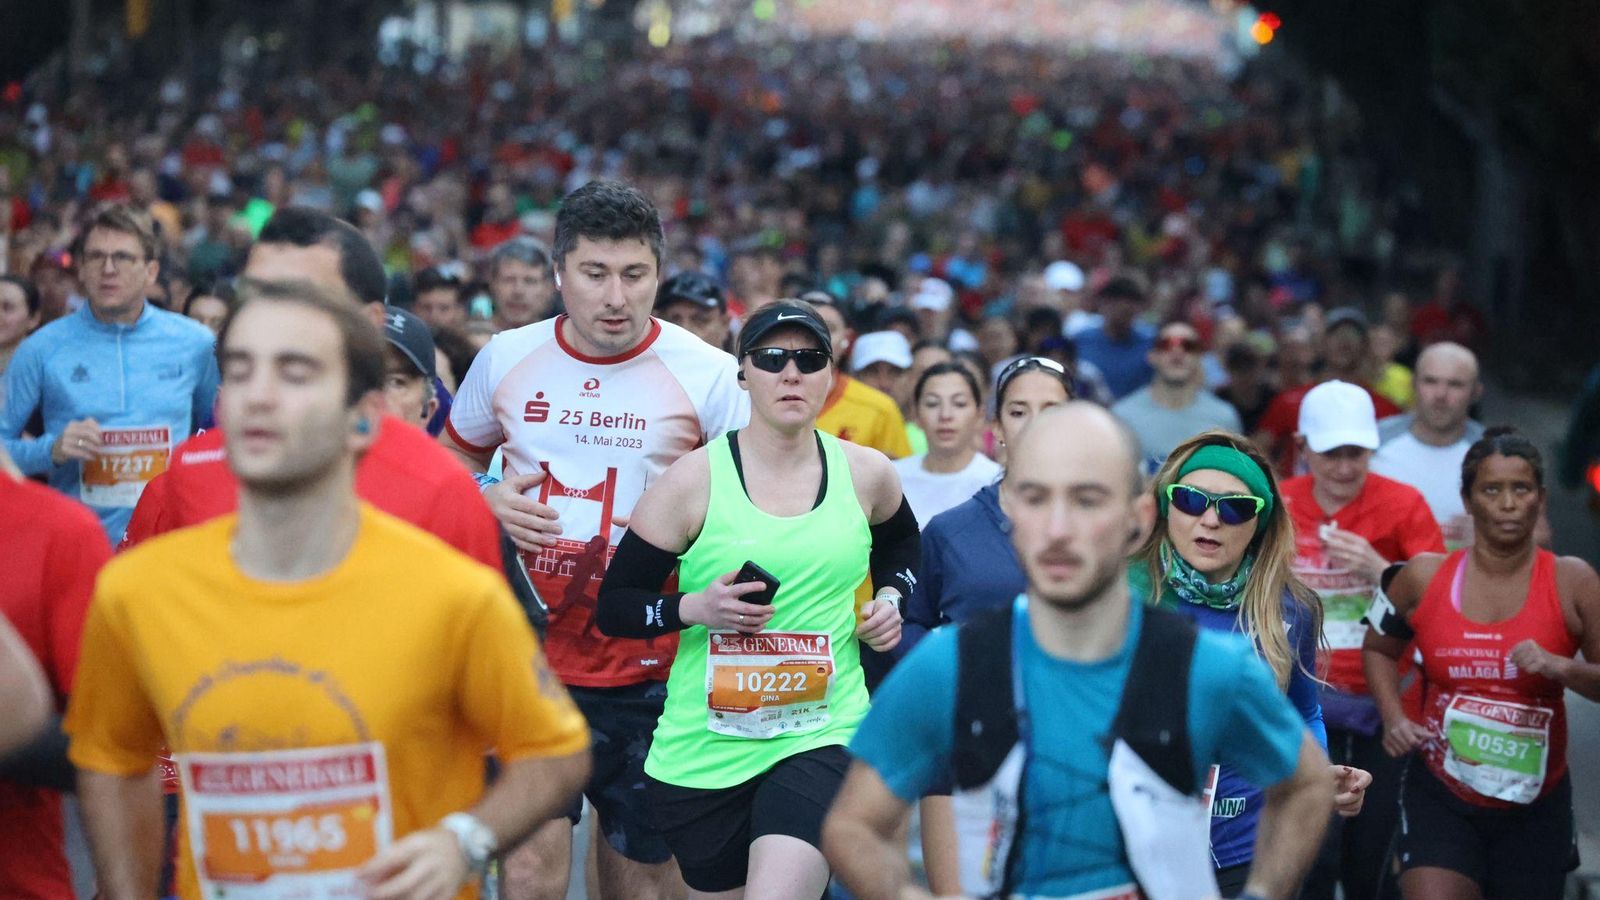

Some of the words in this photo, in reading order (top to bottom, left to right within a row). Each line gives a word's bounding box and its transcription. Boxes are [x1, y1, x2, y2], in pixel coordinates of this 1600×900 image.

[579, 391, 601, 399] artiva
[558, 409, 583, 426] 25
[590, 411, 646, 431] Berlin
[574, 434, 590, 445] 14.
[593, 435, 613, 447] Mai
[615, 436, 643, 449] 2023
[102, 455, 154, 473] 17237
[743, 636, 821, 654] GENERALI
[1448, 664, 1500, 679] MÁLAGA
[735, 671, 807, 692] 10222
[1467, 728, 1530, 760] 10537
[229, 812, 347, 855] 11965
